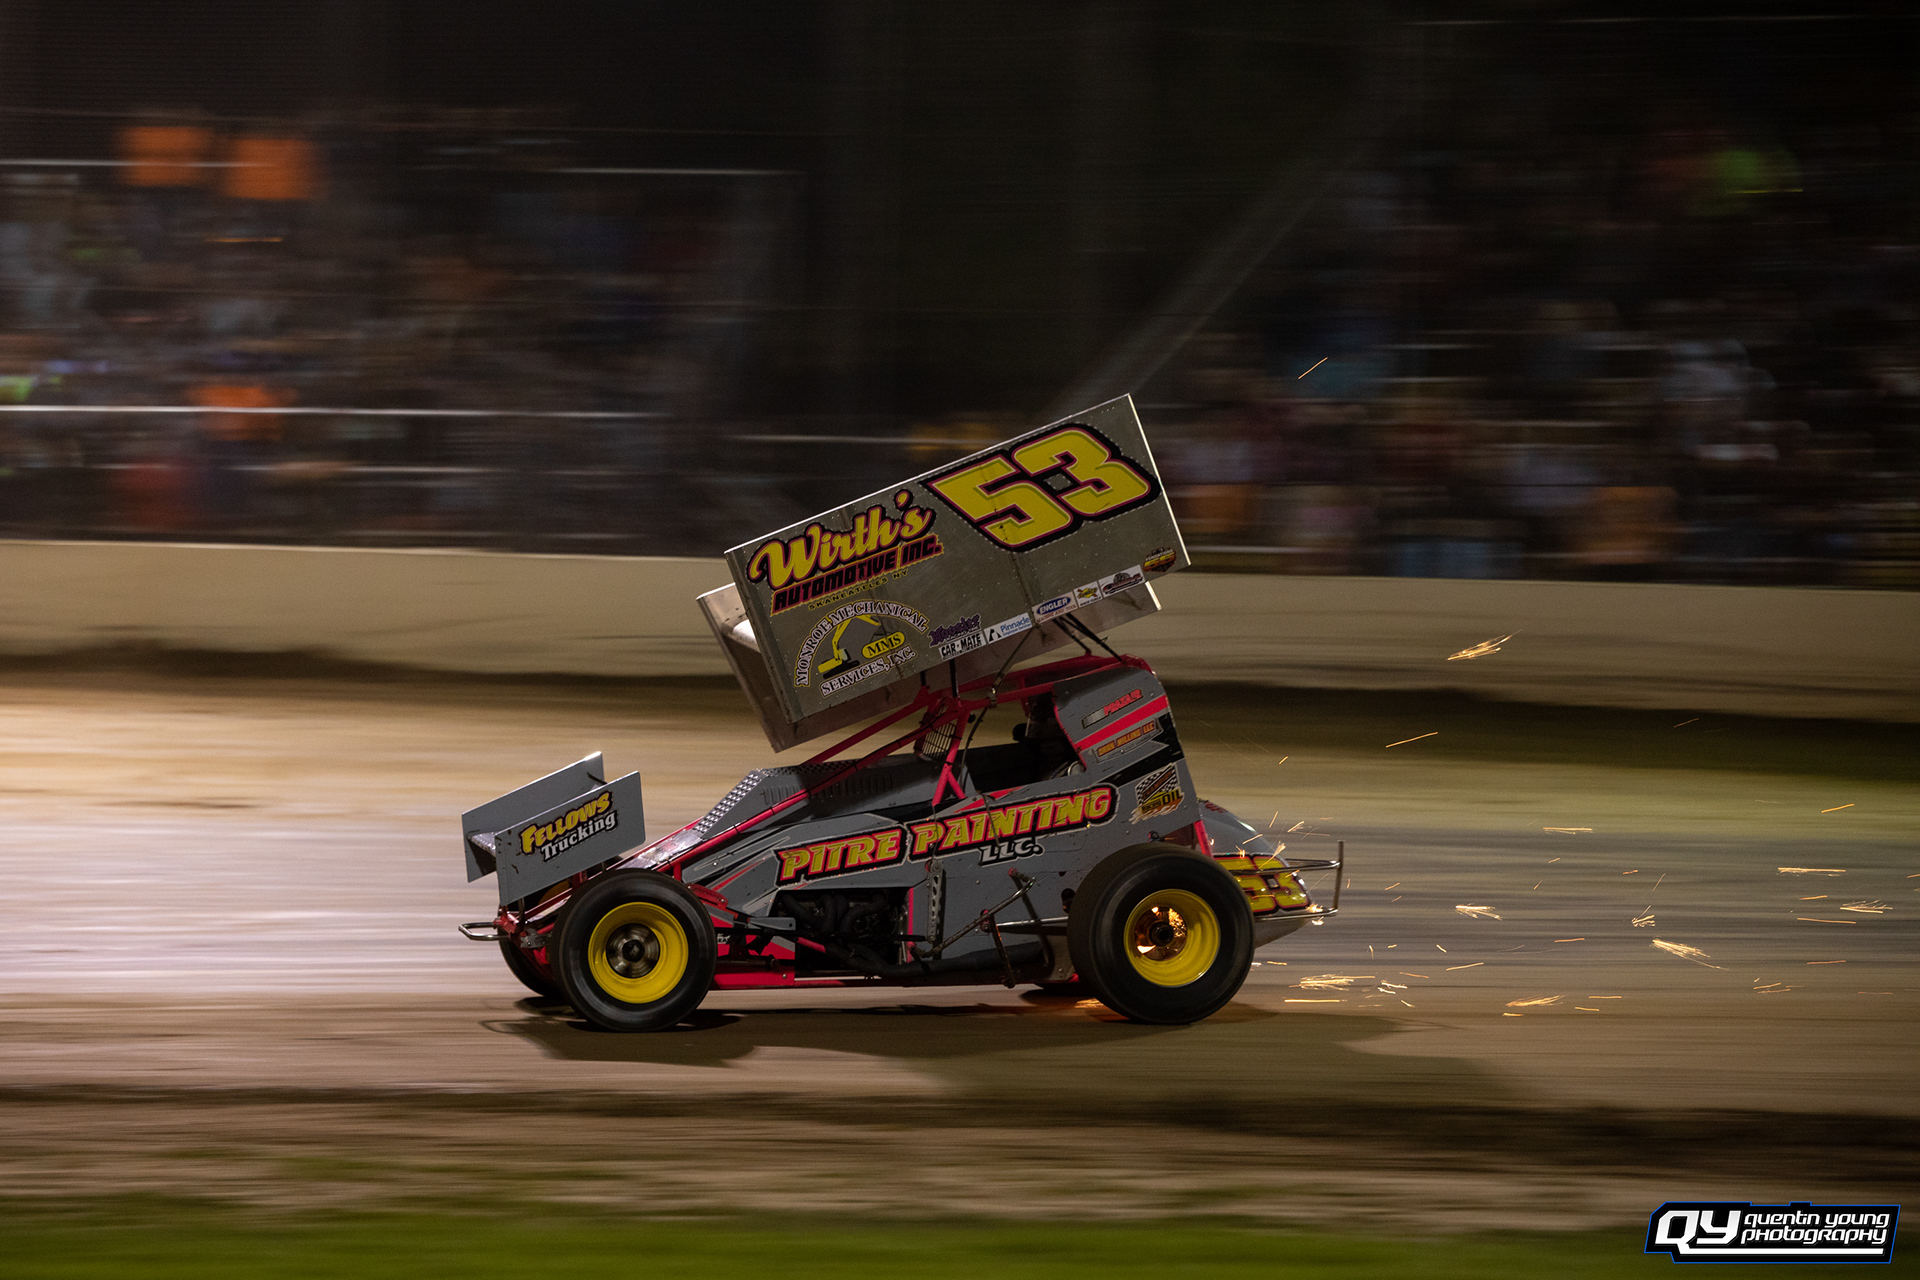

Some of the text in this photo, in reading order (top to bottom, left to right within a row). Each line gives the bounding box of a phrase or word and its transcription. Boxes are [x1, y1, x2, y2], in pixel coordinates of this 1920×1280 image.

[924, 424, 1156, 550] 53
[748, 490, 934, 588] Wirth's
[774, 536, 943, 612] AUTOMOTIVE INC.
[808, 569, 909, 610] SKANEATELES NY
[1000, 616, 1030, 633] Pinnacle
[1039, 597, 1069, 615] ENGLER
[796, 600, 929, 686] MONROE MECHANICAL
[867, 633, 902, 657] MMS
[821, 658, 890, 697] SERVICES,
[889, 646, 916, 667] INC.
[520, 791, 611, 854] FELLOWS
[1162, 789, 1182, 805] OIL
[541, 812, 617, 861] Trucking
[778, 787, 1113, 882] PITRE PAINTING
[979, 838, 1043, 866] LLC.
[1215, 854, 1310, 914] 53
